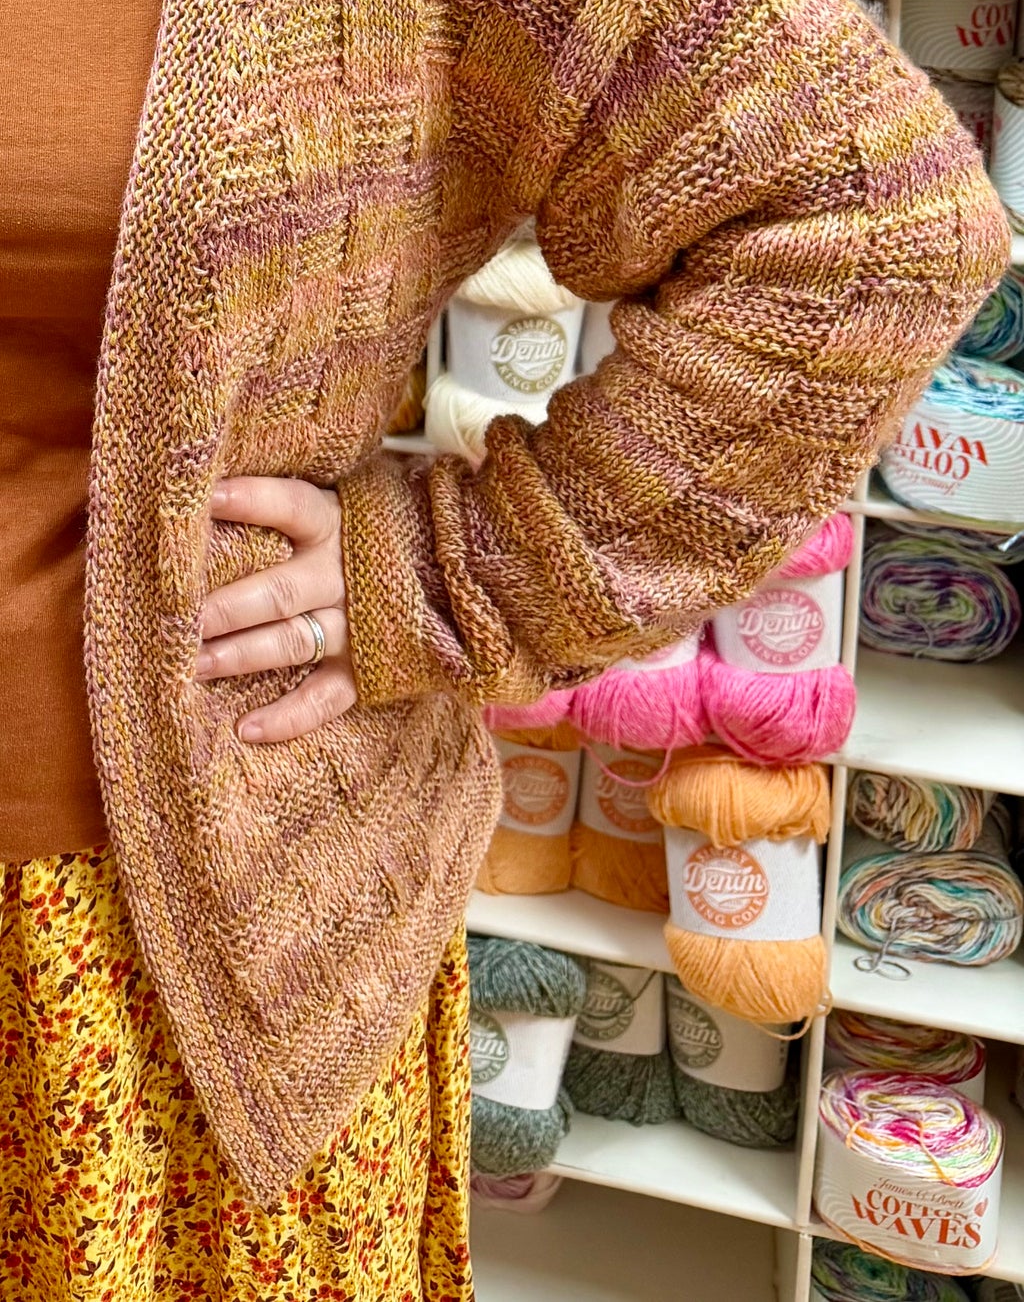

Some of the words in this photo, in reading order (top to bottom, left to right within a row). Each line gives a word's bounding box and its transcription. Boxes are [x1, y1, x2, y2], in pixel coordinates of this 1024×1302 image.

[490, 333, 565, 363] Denim
[737, 605, 823, 636] Denim
[682, 862, 767, 894] Denim
[692, 896, 727, 926] KING
[873, 1176, 913, 1197] James
[850, 1194, 983, 1249] WAVES
[866, 1188, 970, 1224] COTTON
